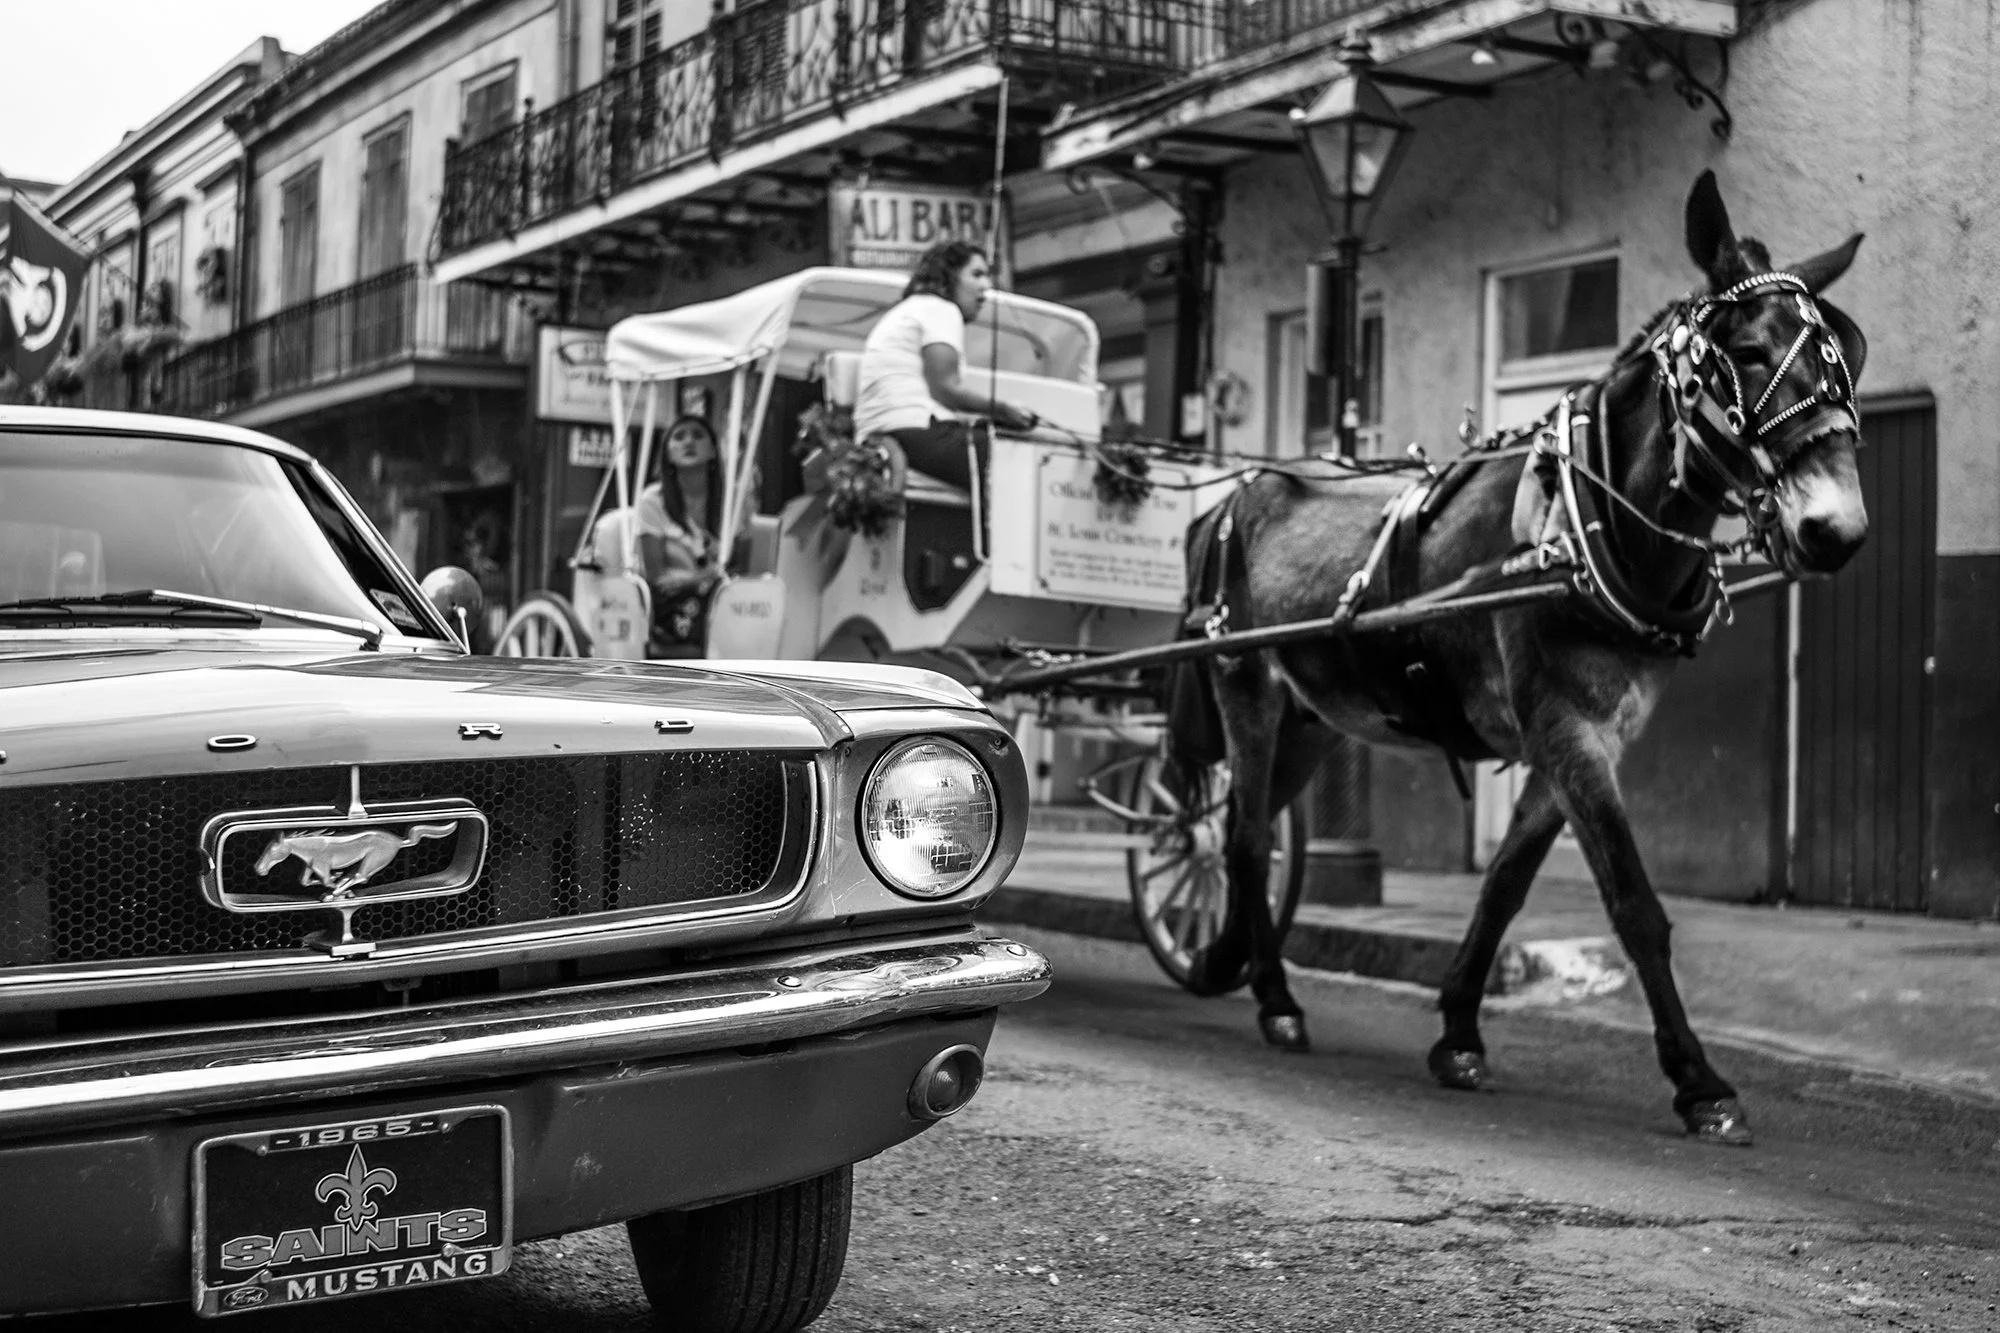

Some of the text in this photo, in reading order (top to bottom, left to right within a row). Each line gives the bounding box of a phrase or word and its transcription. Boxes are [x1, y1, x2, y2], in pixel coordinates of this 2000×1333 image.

[850, 198, 898, 241] ALI
[220, 1208, 487, 1269] SAINTS
[287, 1254, 487, 1301] MUSTANG
